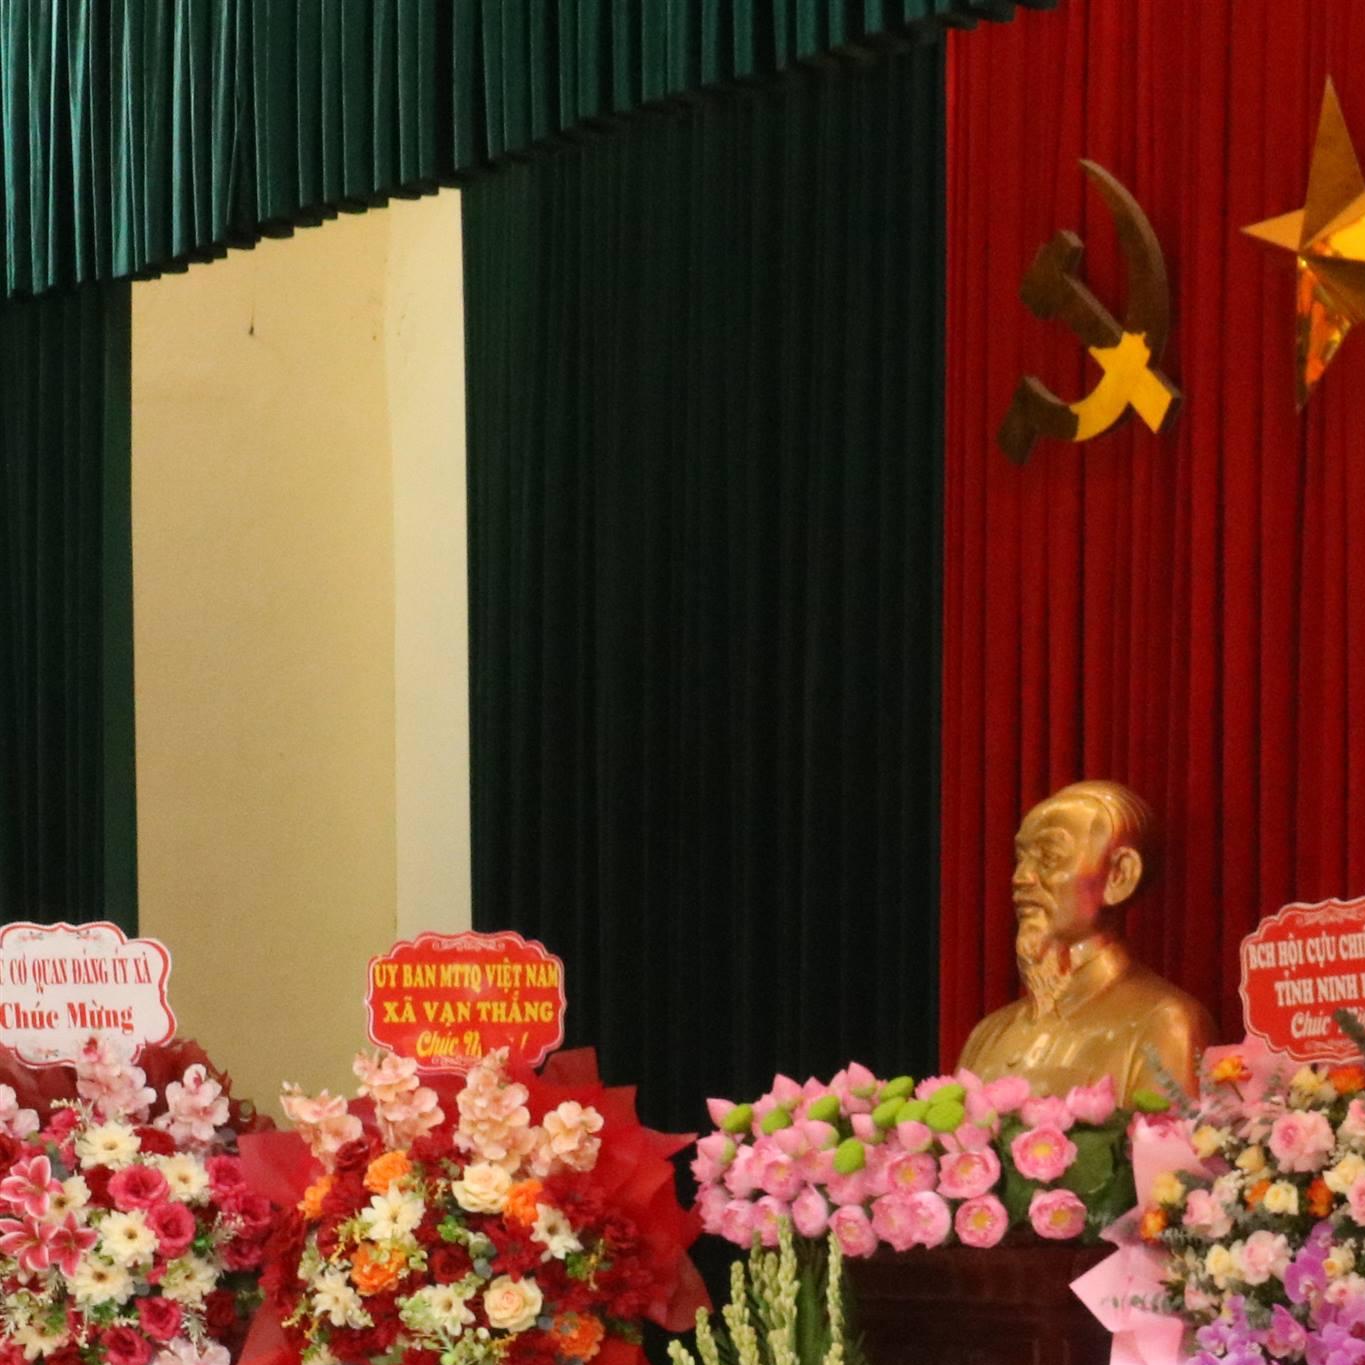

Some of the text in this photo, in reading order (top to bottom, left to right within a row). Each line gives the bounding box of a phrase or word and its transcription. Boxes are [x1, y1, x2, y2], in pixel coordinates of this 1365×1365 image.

[1250, 943, 1275, 970] BCH
[1278, 933, 1304, 971] HỘI
[1307, 931, 1336, 967] CỰU
[32, 957, 68, 994] QUAN
[402, 964, 436, 988] BAN
[440, 963, 481, 993] MTTQ
[485, 957, 522, 994] VIỆT
[526, 964, 559, 988] NAM
[1275, 971, 1313, 1006] TỈNH
[1317, 974, 1359, 1003] NINH
[0, 1000, 134, 1035] Chúc Mừng
[383, 990, 554, 1028] XÃ VẠN THẮNG
